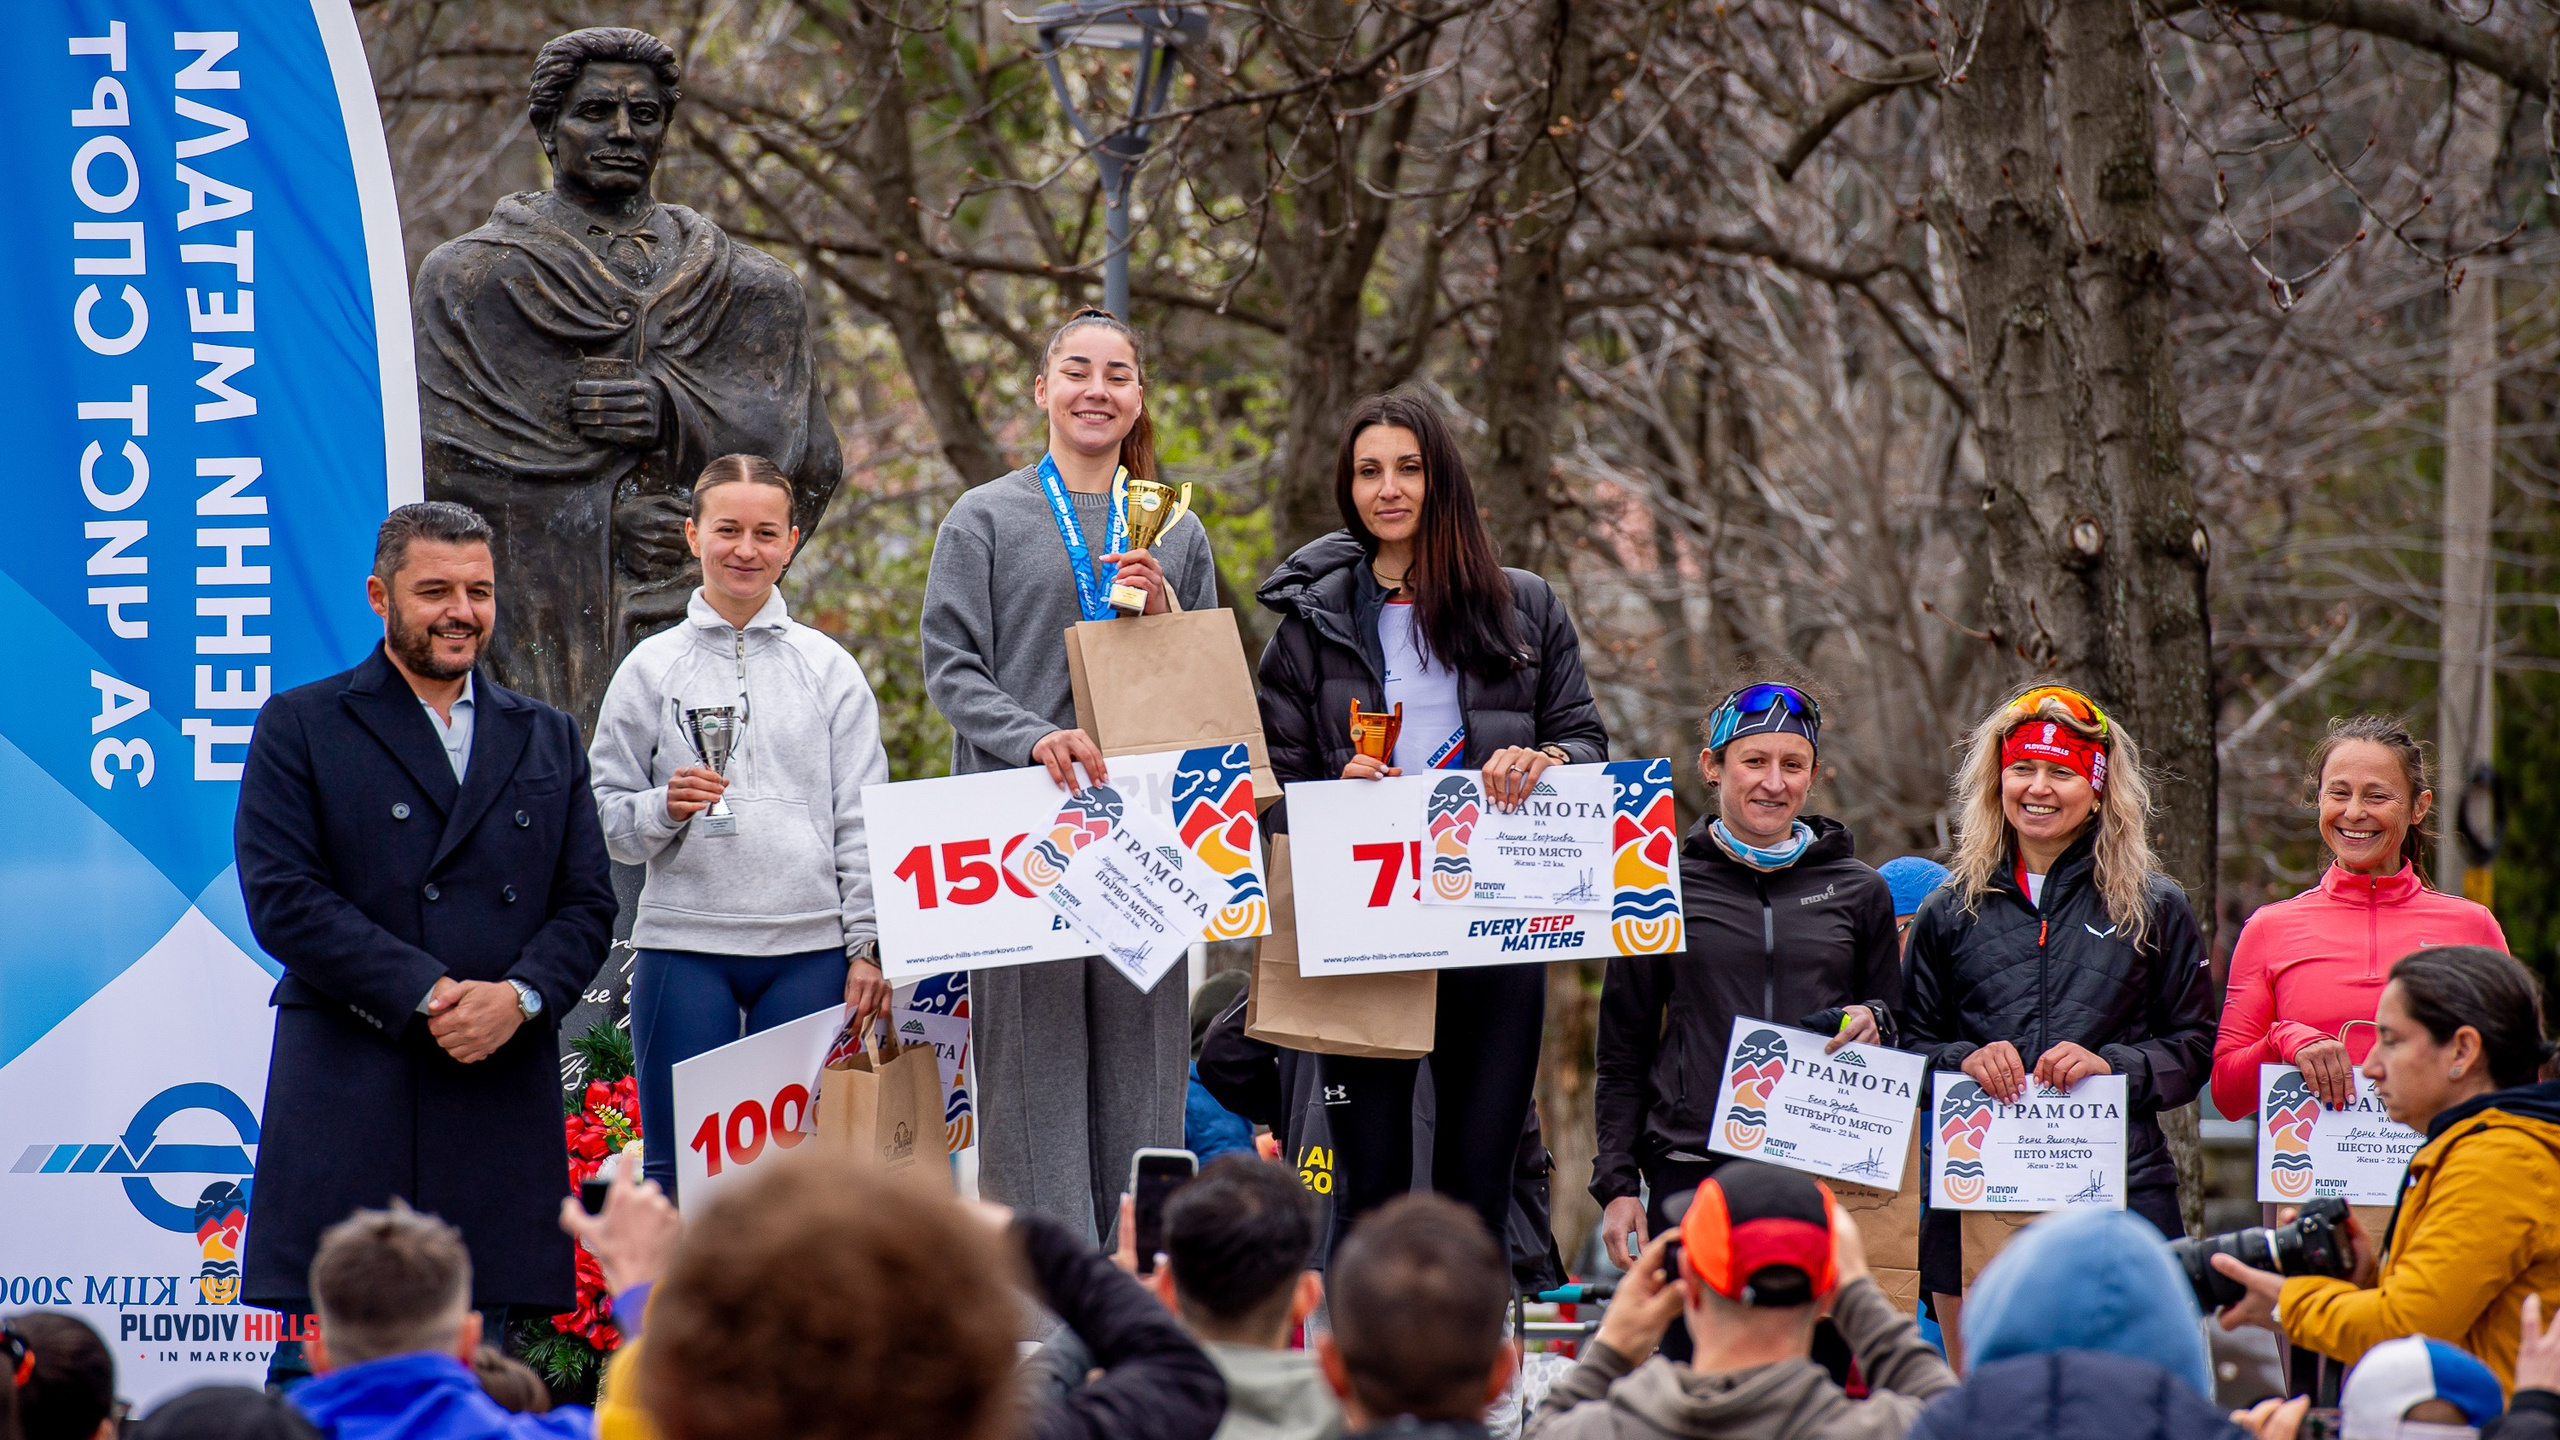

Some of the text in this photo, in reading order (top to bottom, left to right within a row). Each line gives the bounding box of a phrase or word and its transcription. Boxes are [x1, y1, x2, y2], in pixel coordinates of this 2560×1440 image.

[1448, 725, 1466, 745] STE
[1485, 801, 1607, 819] ГАМОТА
[1497, 846, 1582, 858] ТРЕТО МЯСТО
[1113, 828, 1208, 918] ГРАМОТА
[1352, 840, 1421, 908] 7
[1143, 875, 1155, 887] НА
[1474, 882, 1506, 891] PLOVDIV
[1049, 890, 1067, 908] HILLS
[1055, 883, 1081, 907] PLOVDIV
[1095, 870, 1130, 903] ПЪРВО
[1128, 901, 1164, 934] МЯСТО
[1474, 891, 1495, 900] HILLS
[1468, 915, 1575, 938] EVERY STEP
[1501, 931, 1585, 952] MATTERS
[906, 944, 1034, 965] www.plovdiv-hills-in-markovo.com
[1323, 949, 1449, 964] www.plovdiv-hills-in-markovo.com
[1790, 1058, 1911, 1098] ГРАМОТА
[1838, 1087, 1850, 1096] НА
[1998, 1103, 2120, 1119] ГРАМОТА
[1784, 1103, 1892, 1136] ЧЕТВЪРТО МЯСТО
[1809, 1122, 1832, 1134] Жени
[1838, 1129, 1847, 1137] 22
[1763, 1146, 1784, 1157] HILLS
[1765, 1137, 1797, 1151] PLOVDIV
[2337, 1142, 2421, 1154] ШЕСТО МЯСТ
[2014, 1149, 2092, 1159] ПЕТО МЯСТО
[1986, 1186, 2018, 1194] PLOVDIV
[2315, 1179, 2348, 1188] PLOVDIV
[1986, 1195, 2007, 1203] HILLS
[2315, 1188, 2336, 1197] HILLS
